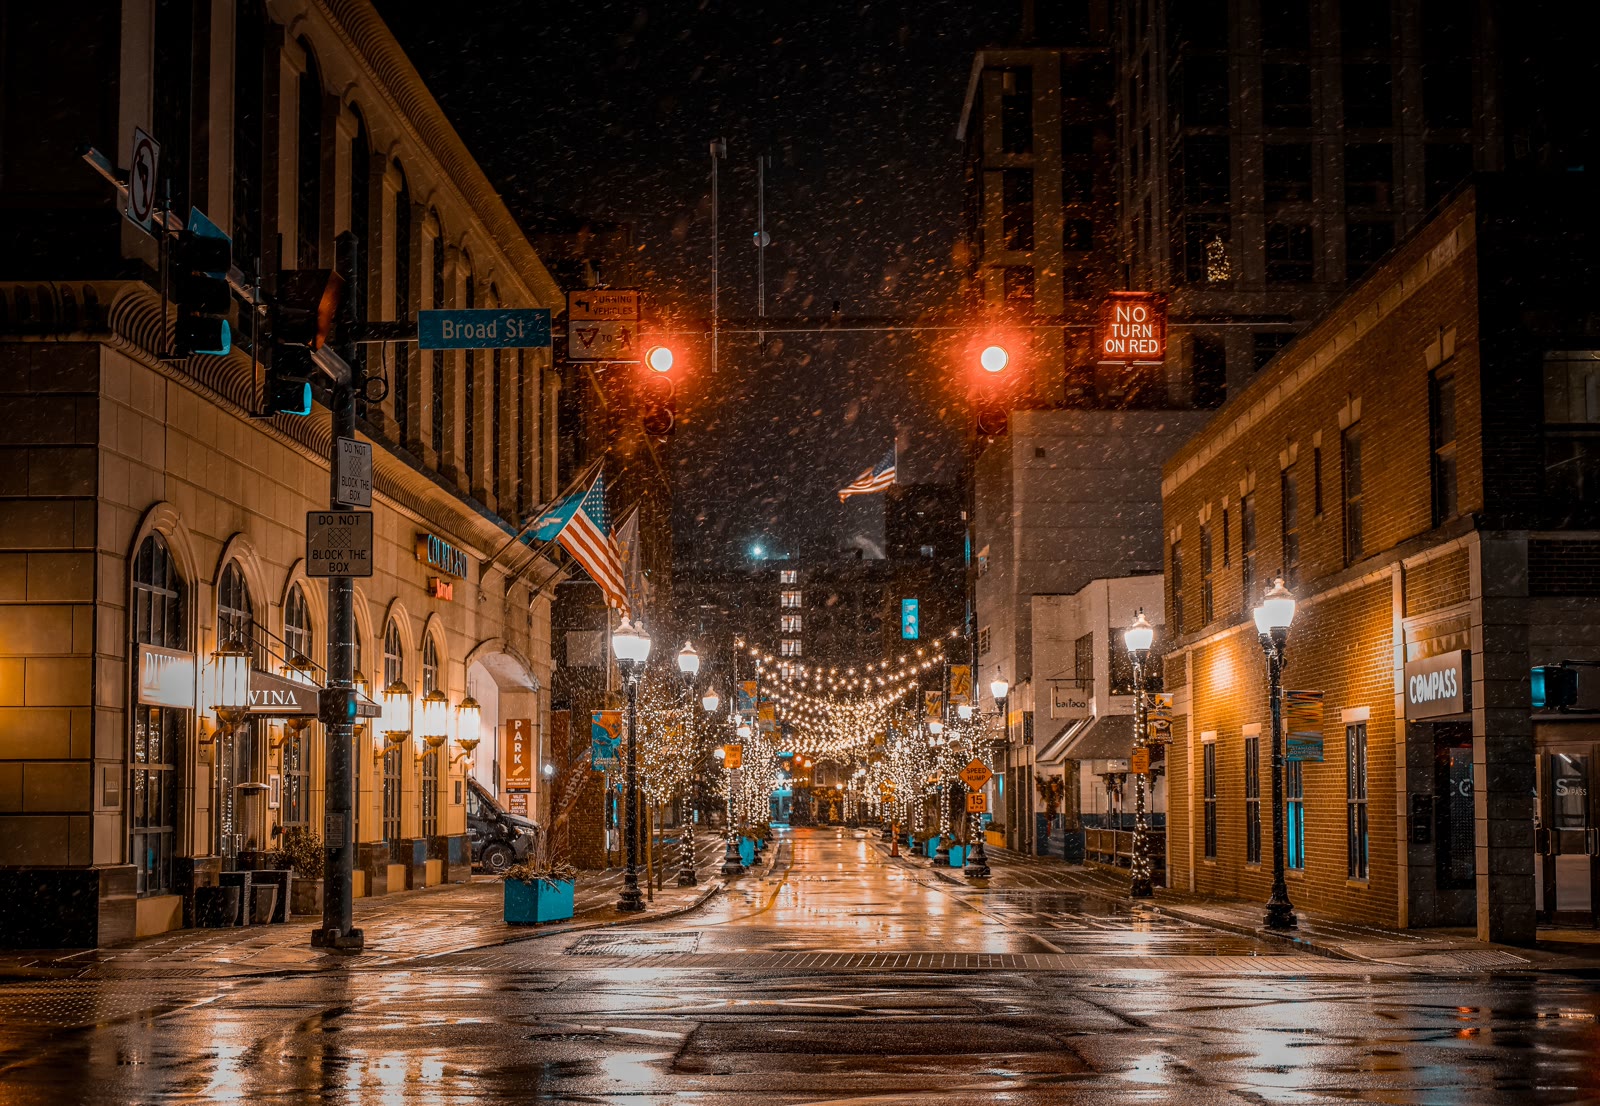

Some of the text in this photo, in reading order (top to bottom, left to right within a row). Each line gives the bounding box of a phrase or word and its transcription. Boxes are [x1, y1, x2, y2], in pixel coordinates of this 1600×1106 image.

[594, 296, 632, 304] TURNING
[593, 307, 633, 315] VEHICLES
[1116, 306, 1146, 323] NO
[441, 318, 525, 339] Broad St
[1111, 323, 1152, 338] TURN
[602, 334, 612, 343] TO
[1105, 339, 1158, 353] ON RED
[344, 442, 366, 456] DO NOT
[341, 476, 370, 490] BLOCK THE
[349, 490, 361, 501] BOX
[318, 515, 361, 526] DO NOT
[312, 549, 367, 560] BLOCK THE
[328, 562, 350, 573] BOX
[1409, 667, 1457, 704] COMPASS
[513, 720, 523, 764] PARK
[559, 762, 586, 807] bubble
[970, 795, 984, 805] 15
